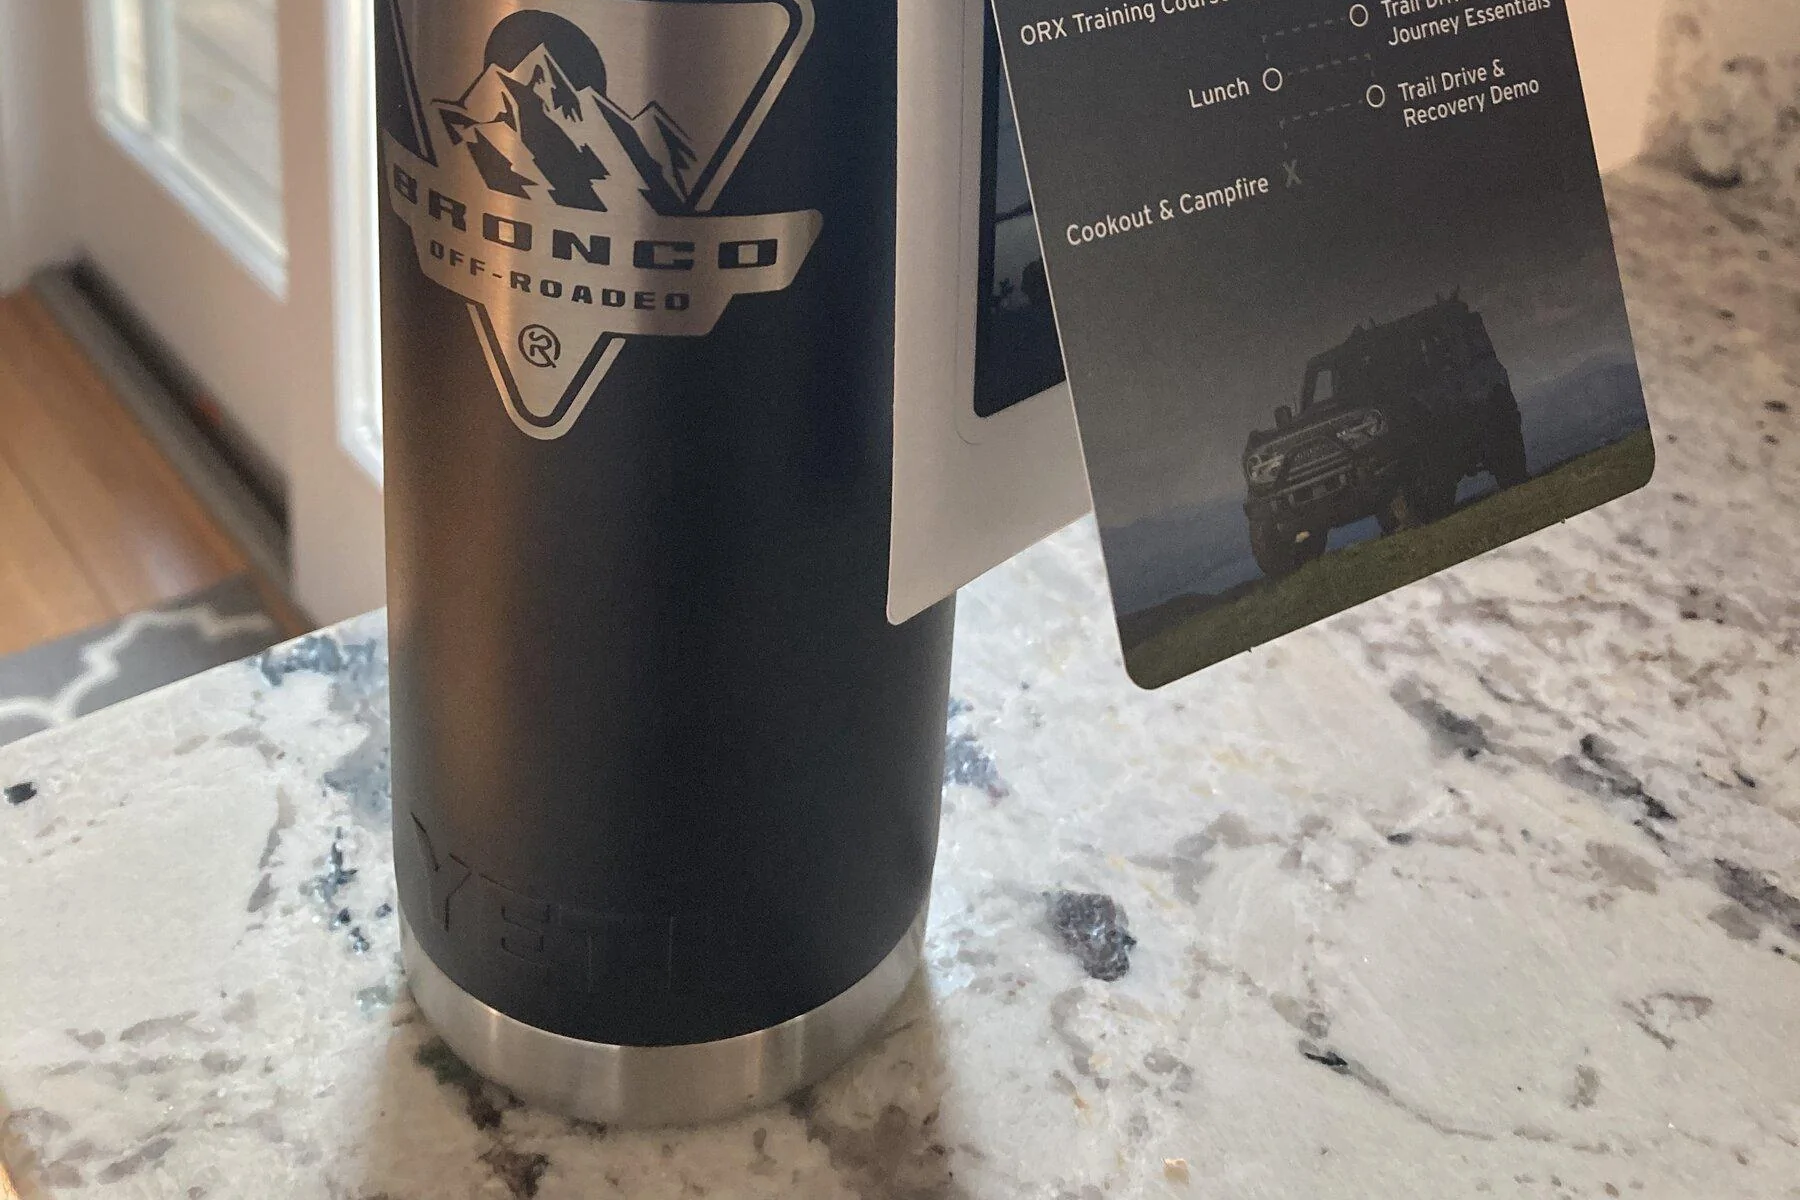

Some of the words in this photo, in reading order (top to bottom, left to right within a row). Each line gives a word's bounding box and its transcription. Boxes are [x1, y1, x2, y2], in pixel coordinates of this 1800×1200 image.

[1020, 17, 1068, 46] ORX
[1072, 2, 1157, 34] Training
[1388, 15, 1460, 46] Journey
[1188, 76, 1250, 109] Lunch
[1398, 75, 1437, 102] Trail
[1441, 65, 1488, 92] Drive
[1492, 58, 1506, 78] &
[1402, 93, 1486, 128] Recovery
[1490, 78, 1541, 105] Demo
[393, 164, 778, 270] BRONCO
[1066, 204, 1154, 246] Cookout
[1158, 199, 1175, 221] &
[1179, 176, 1270, 215] Campfire
[429, 240, 690, 312] OFF-ROADEO
